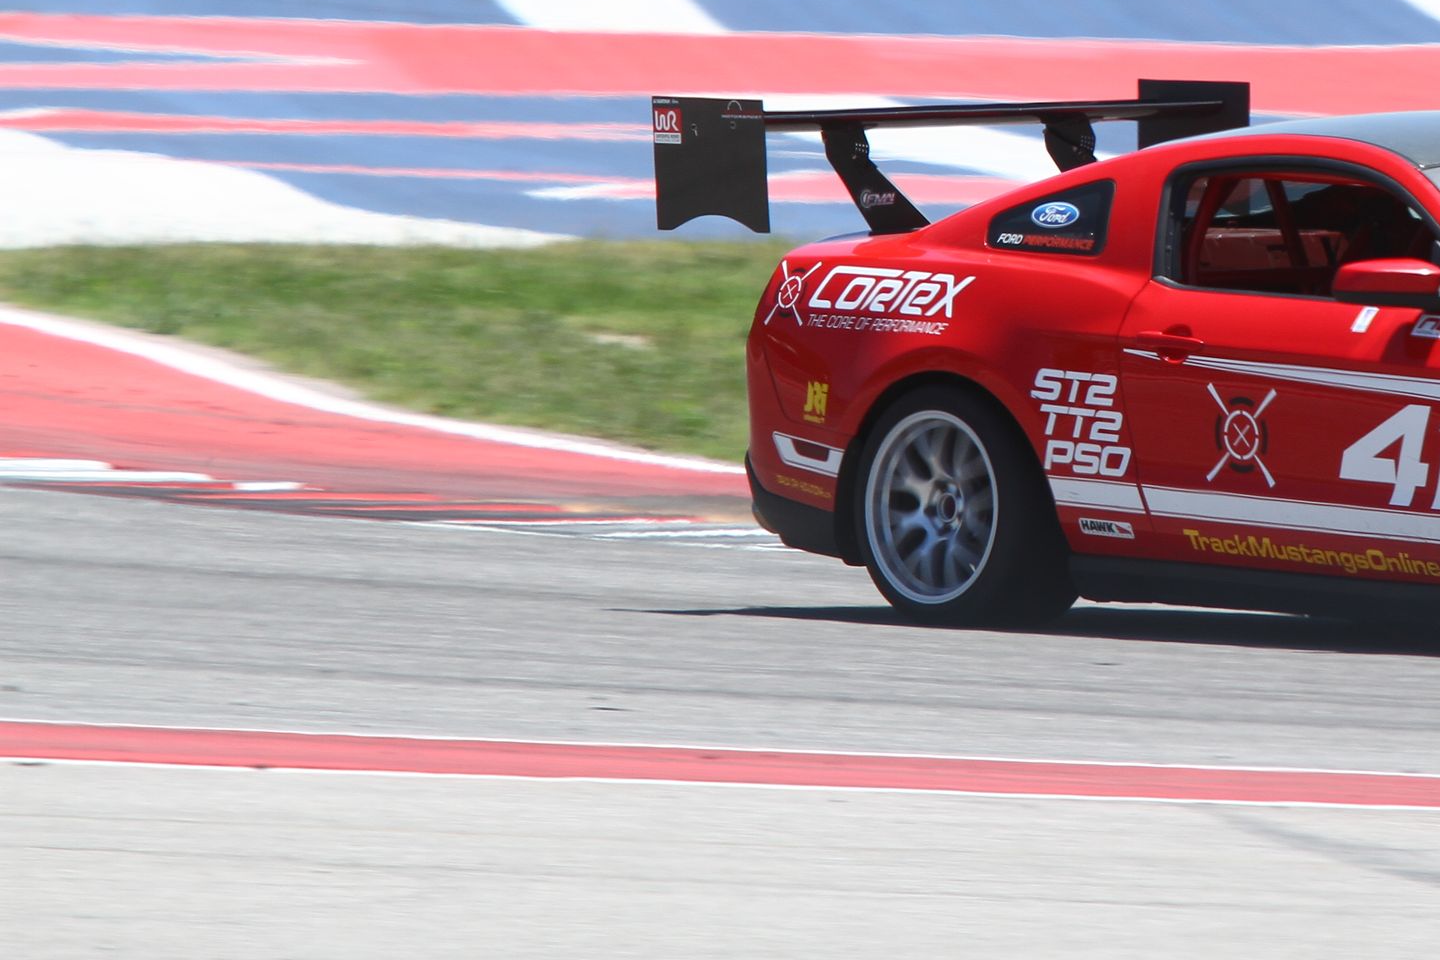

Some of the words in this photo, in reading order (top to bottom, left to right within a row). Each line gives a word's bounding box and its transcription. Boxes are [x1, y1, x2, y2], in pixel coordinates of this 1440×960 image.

[997, 233, 1024, 244] FORD
[807, 314, 828, 328] THE
[827, 315, 856, 330] CORE
[855, 317, 873, 331] OF
[871, 319, 949, 336] PERFORMANCE
[1031, 368, 1118, 406] ST2
[1040, 404, 1123, 442] TT2
[1081, 520, 1116, 533] HAWK
